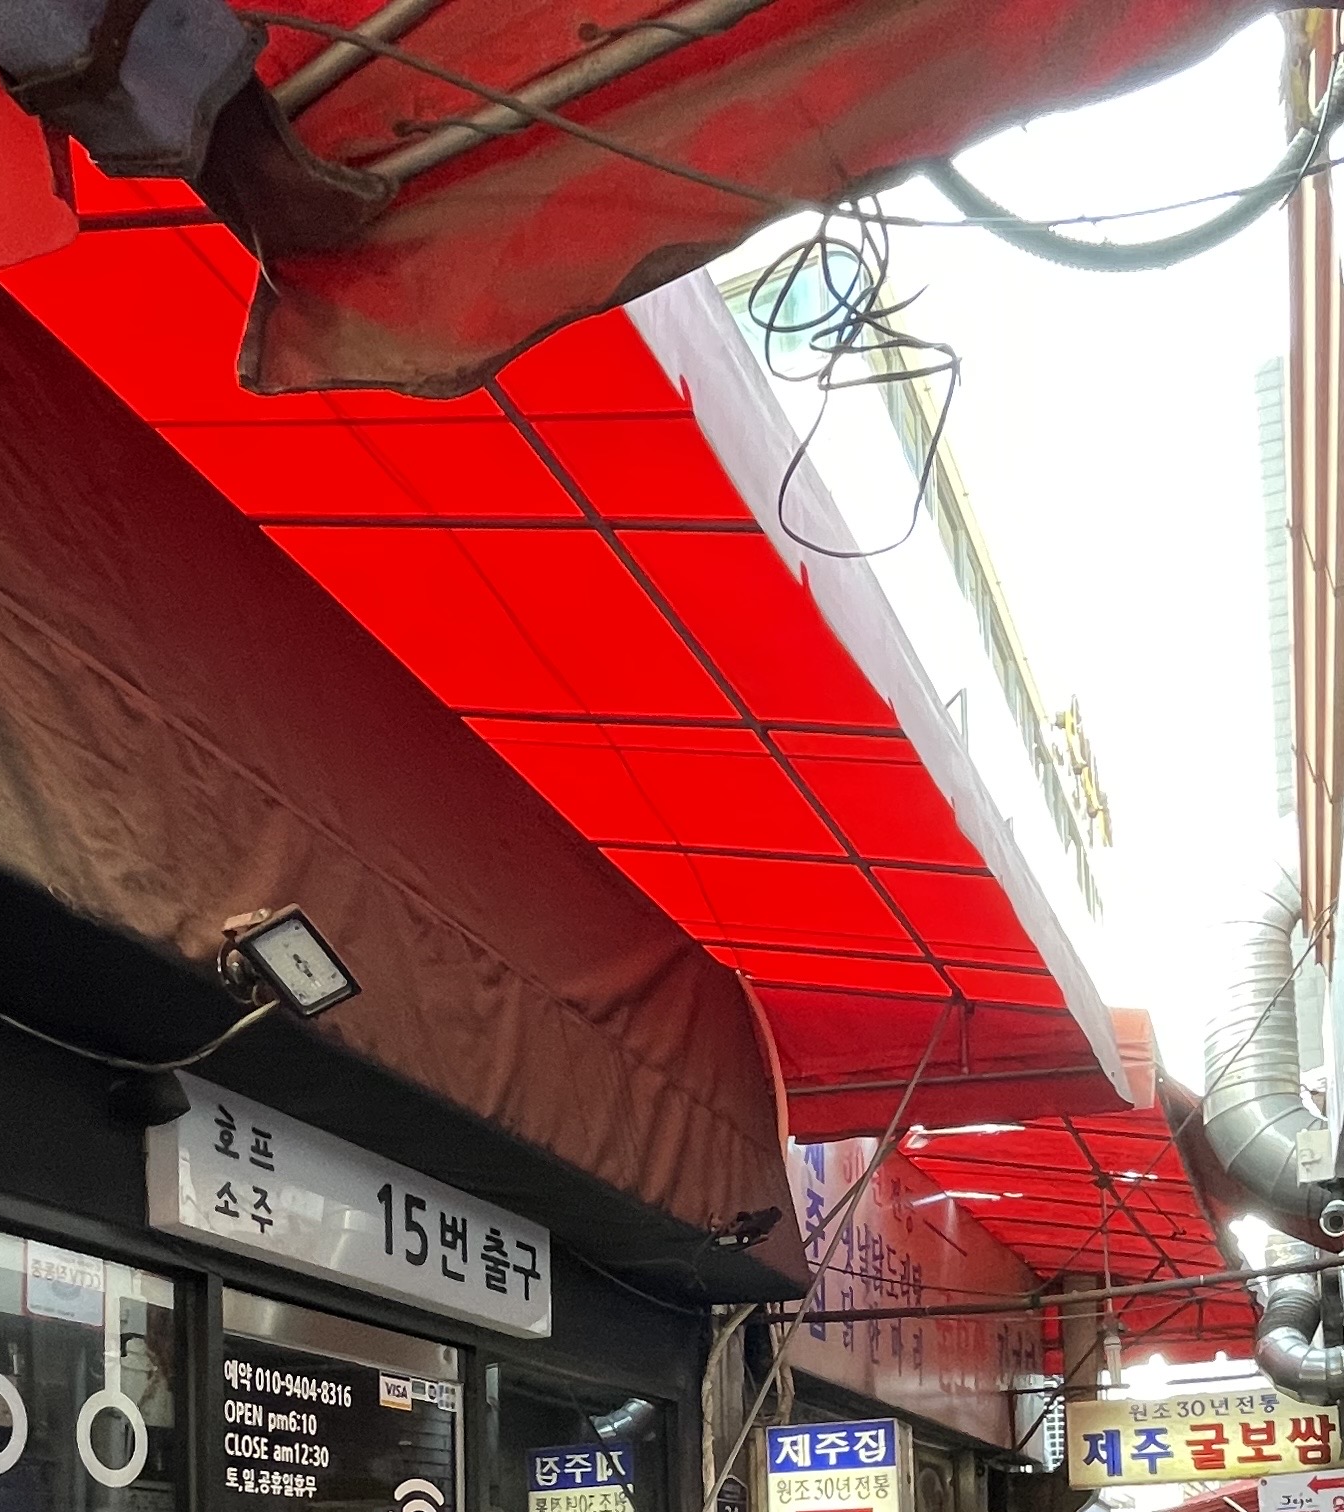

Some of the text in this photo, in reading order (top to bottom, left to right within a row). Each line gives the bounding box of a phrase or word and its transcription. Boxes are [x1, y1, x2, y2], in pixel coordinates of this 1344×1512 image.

[213, 1181, 275, 1235] 소주
[224, 1359, 353, 1408] 예약 010-9404-8316
[385, 1381, 409, 1400] VISA
[224, 1400, 318, 1437] OPEN pm6:10
[224, 1432, 330, 1468] CLOSE am12:30
[775, 1428, 887, 1468] 제주집
[1083, 1414, 1338, 1477] 제주 굴보쌈
[1281, 1493, 1314, 1509] Jeju
